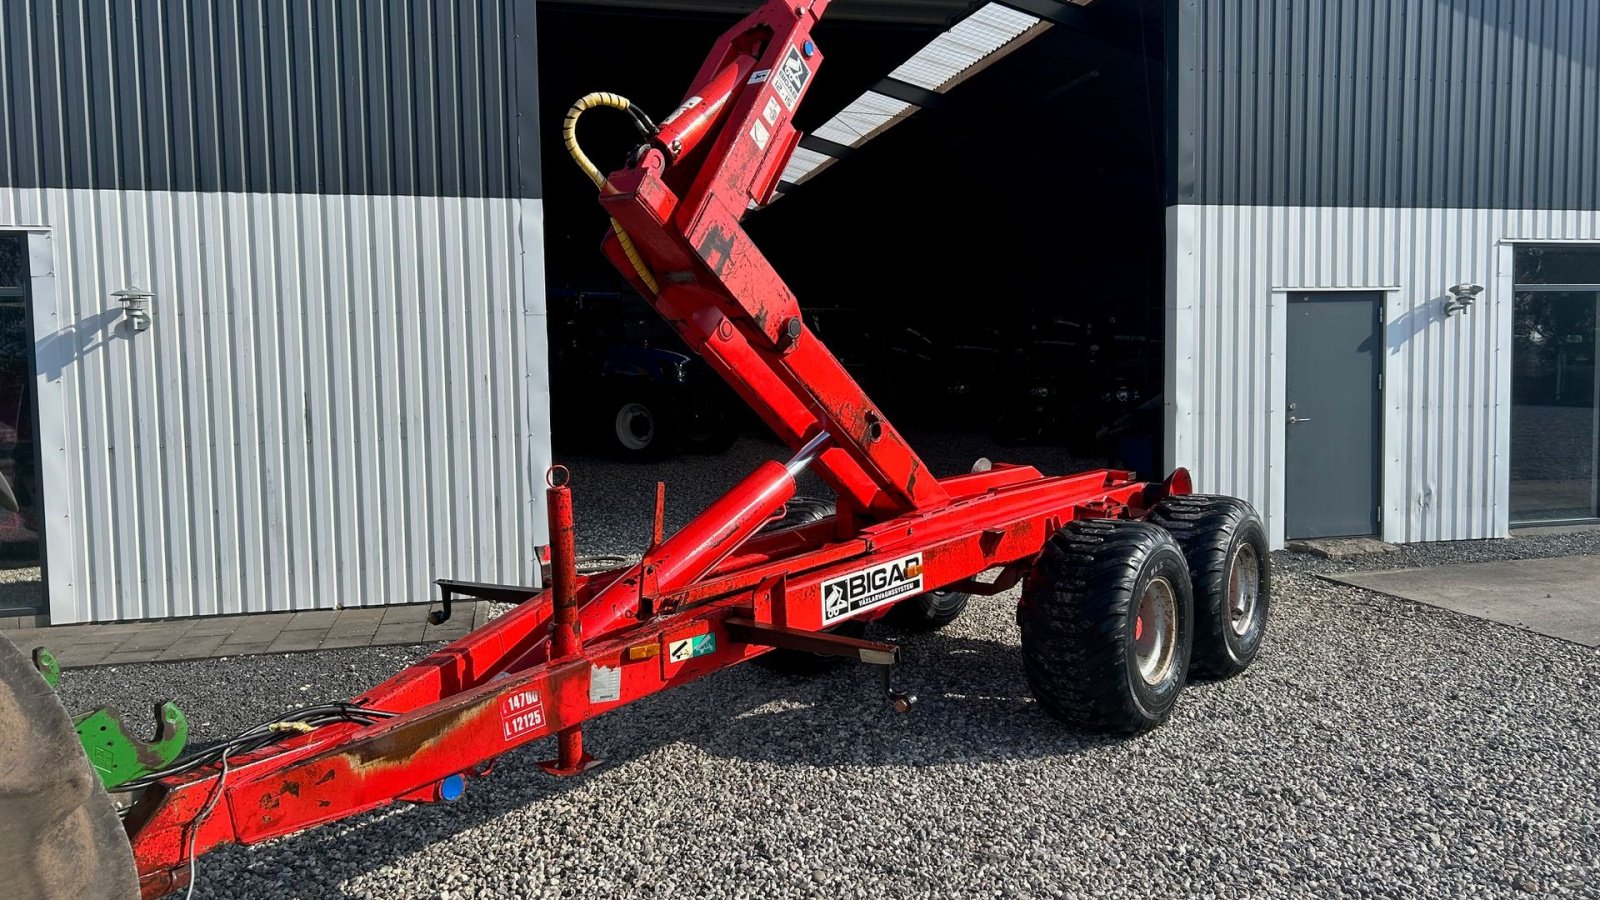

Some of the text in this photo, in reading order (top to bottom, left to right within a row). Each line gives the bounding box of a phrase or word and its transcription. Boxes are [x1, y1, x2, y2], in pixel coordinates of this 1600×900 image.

[779, 71, 797, 99] BIGAB
[505, 710, 541, 736] L 12125
